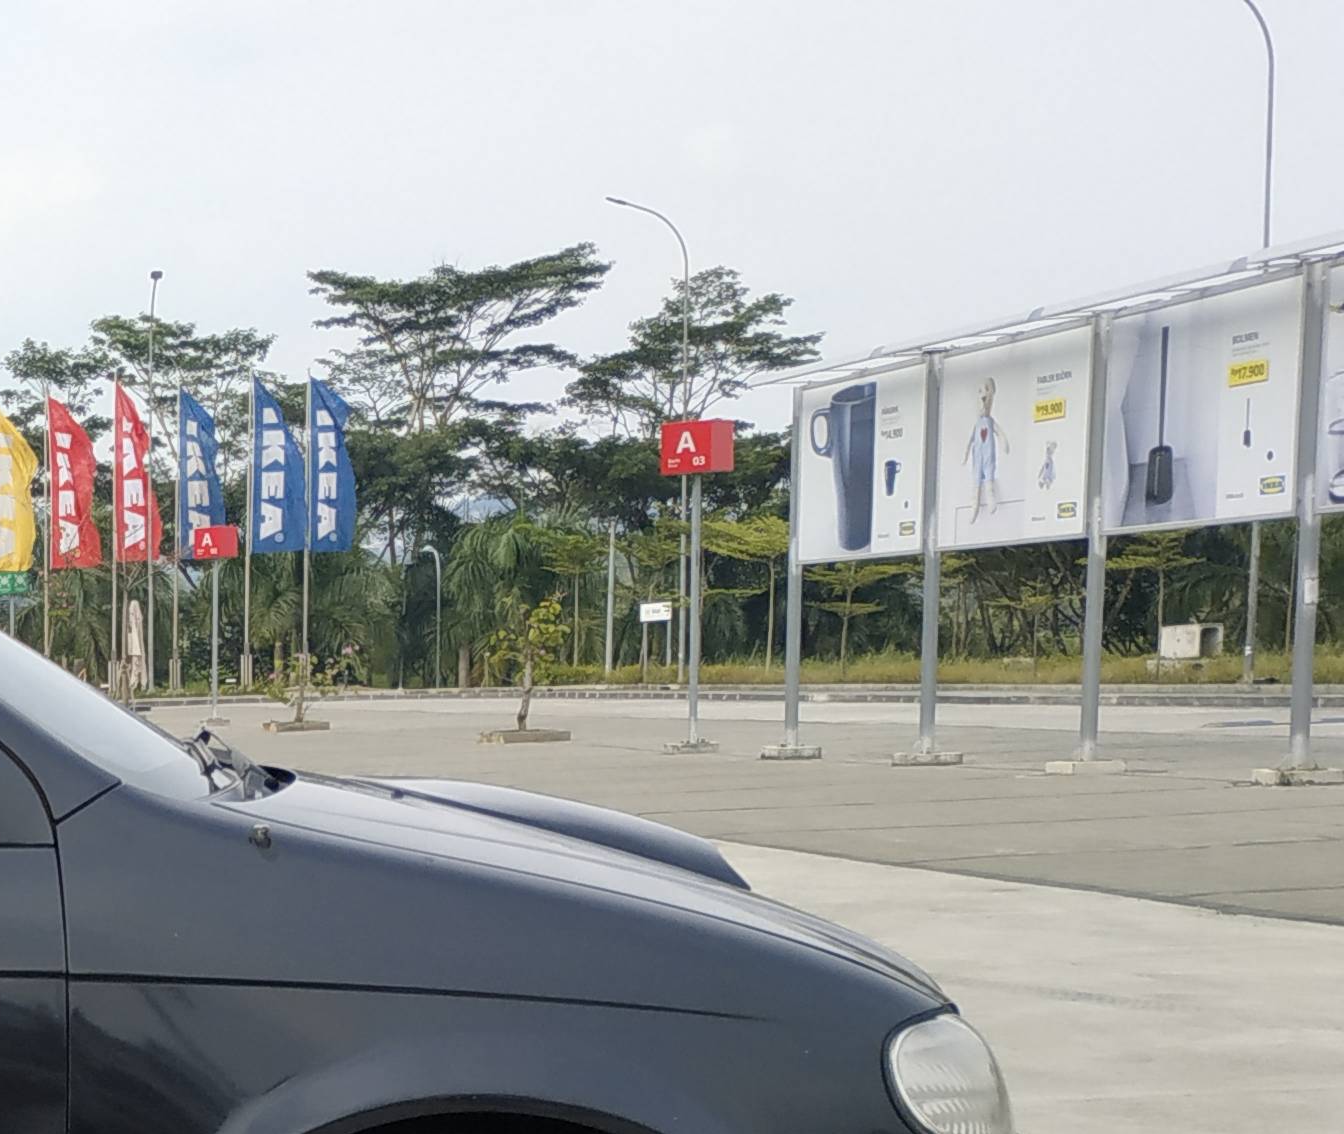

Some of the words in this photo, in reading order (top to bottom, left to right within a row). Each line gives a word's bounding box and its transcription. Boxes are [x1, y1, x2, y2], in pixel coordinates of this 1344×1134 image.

[259, 407, 286, 541] IKEA
[316, 409, 339, 542] IKEA
[675, 431, 697, 454] A
[692, 455, 706, 466] 03
[54, 431, 80, 556] IKEA
[201, 532, 213, 547] A
